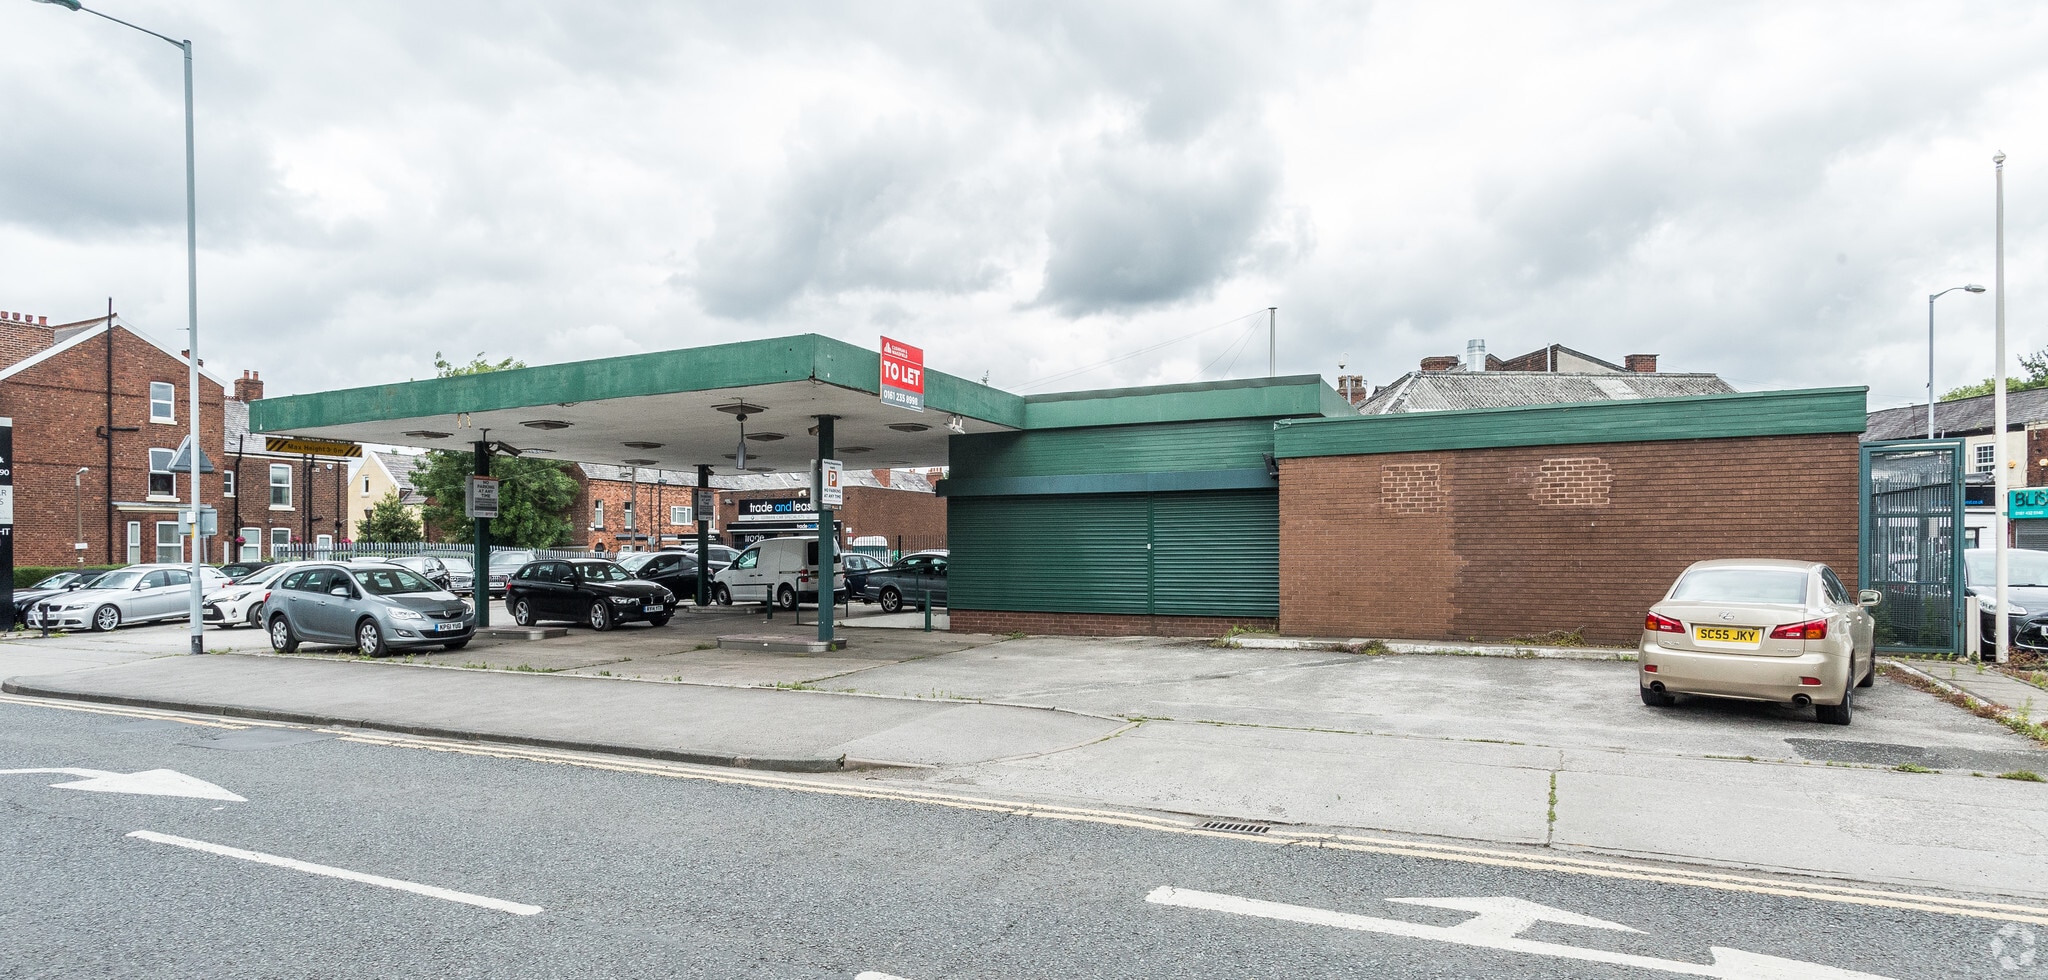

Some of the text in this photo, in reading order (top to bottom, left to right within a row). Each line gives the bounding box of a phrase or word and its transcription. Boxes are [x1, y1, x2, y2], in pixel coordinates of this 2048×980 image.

[883, 360, 920, 386] TO LET
[883, 389, 896, 401] 0161
[896, 392, 906, 403] 235
[303, 444, 325, 453] Height
[829, 471, 837, 486] P
[2015, 490, 2048, 507] BLIS
[749, 500, 773, 513] trade
[774, 500, 792, 512] and
[792, 500, 811, 512] leas
[1700, 628, 1755, 642] SC55 JKY
